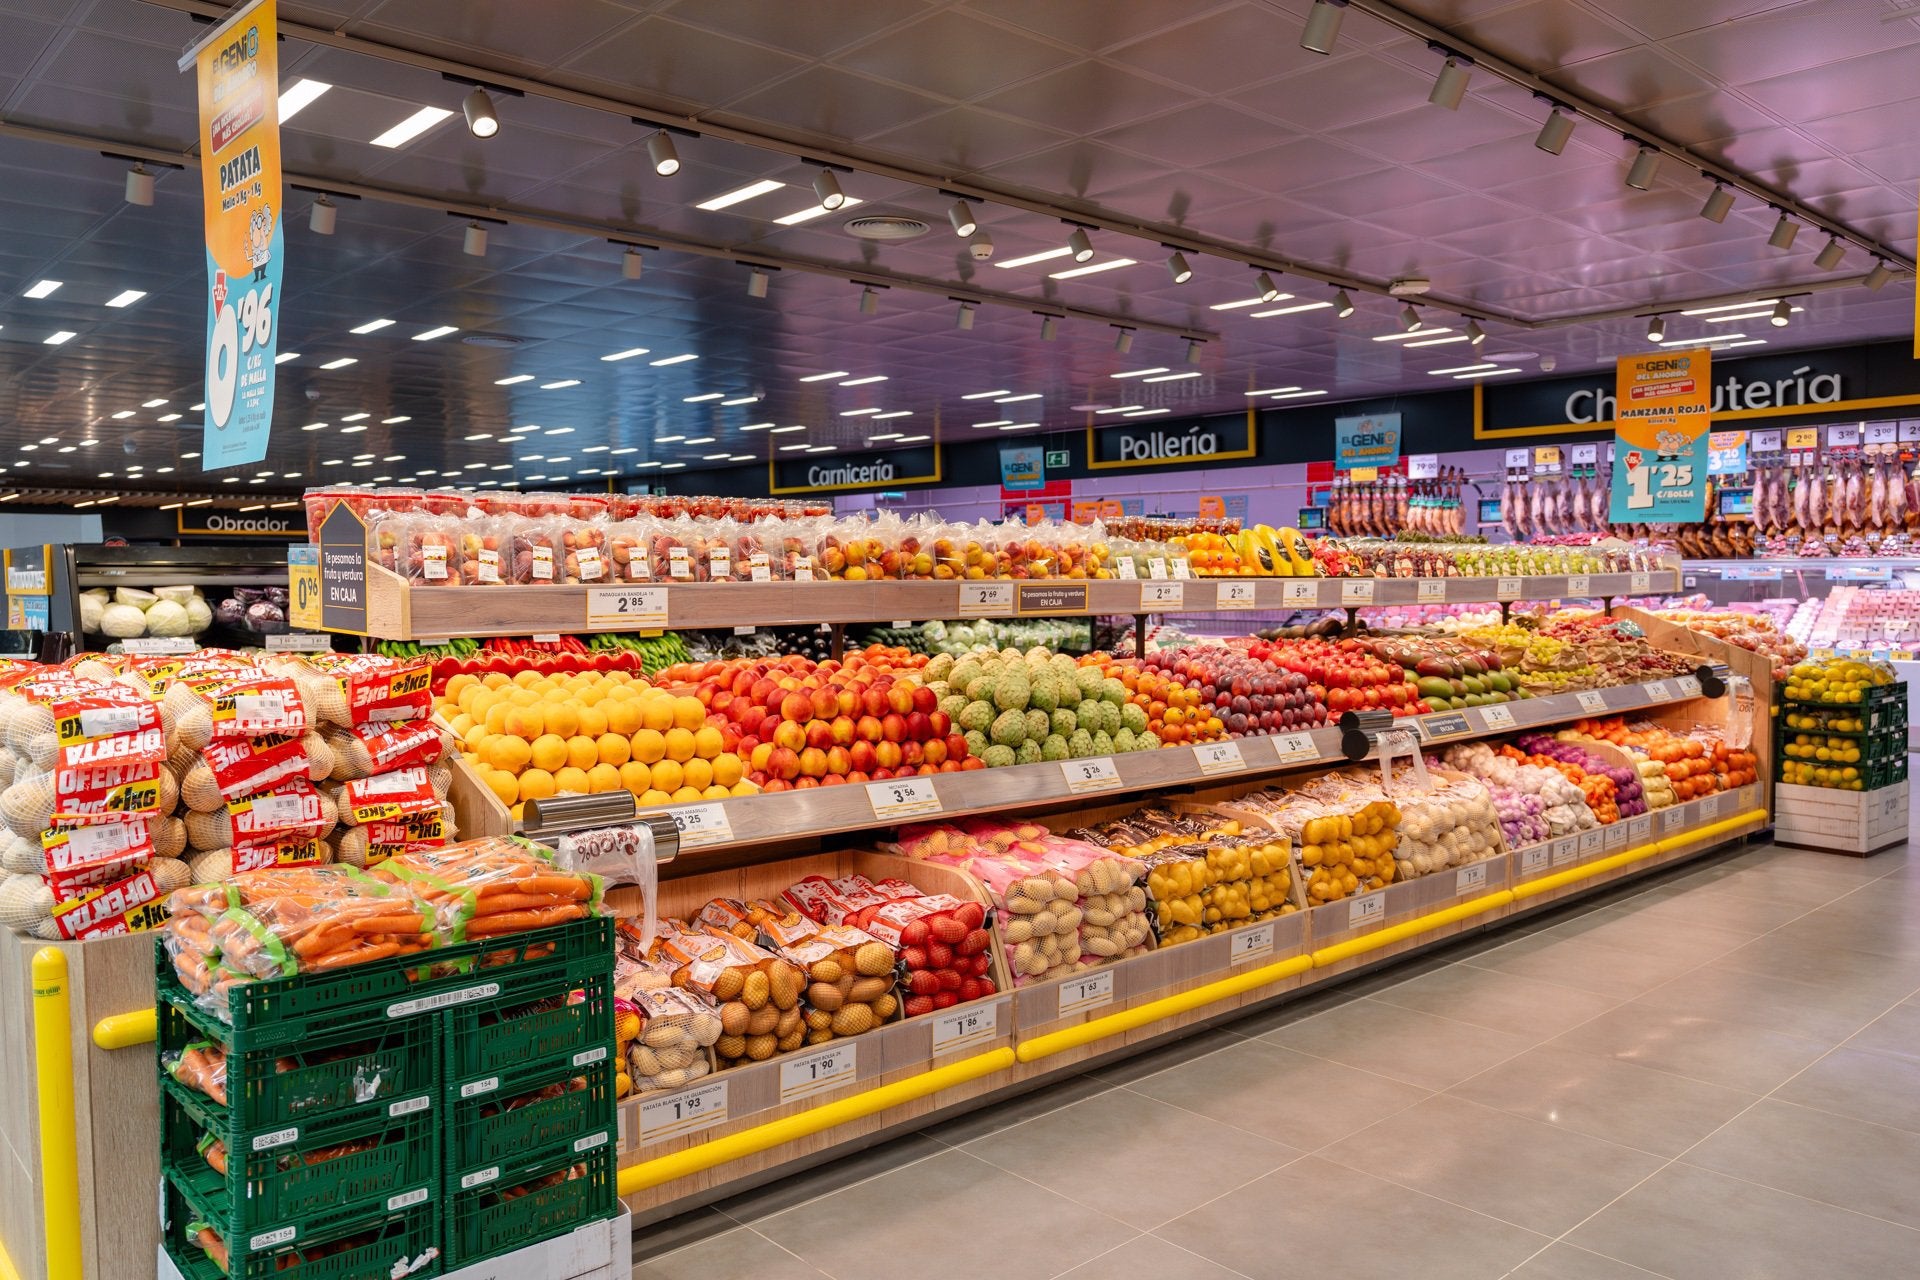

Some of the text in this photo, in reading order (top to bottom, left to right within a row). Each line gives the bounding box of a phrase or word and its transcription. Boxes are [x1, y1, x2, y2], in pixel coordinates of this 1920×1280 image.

[220, 145, 262, 193] PATATA
[1620, 407, 1675, 418] MANZANA
[1119, 426, 1218, 460] Pollería
[807, 459, 895, 488] Carnicería
[206, 514, 289, 532] Obrador
[324, 552, 330, 564] Te
[331, 554, 355, 566] pesamos
[355, 552, 362, 565] la
[324, 567, 337, 580] fruta
[341, 568, 363, 581] verdura
[330, 587, 357, 602] EN CAJA
[1049, 598, 1063, 606] CAJA
[353, 673, 429, 708] 3KG +1KG
[66, 728, 162, 766] OFERTA
[211, 742, 251, 772] 3KG
[58, 761, 154, 794] OFERTA
[109, 786, 156, 812] +1KG
[371, 822, 442, 844] 3KG +1KG
[235, 841, 316, 873] 3KG +1KG
[61, 873, 156, 937] OFERTA
[481, 1080, 492, 1088] 154
[642, 1102, 662, 1112] PATATA
[282, 1130, 295, 1140] 154
[481, 1169, 492, 1177] 154
[279, 1229, 293, 1238] 154
